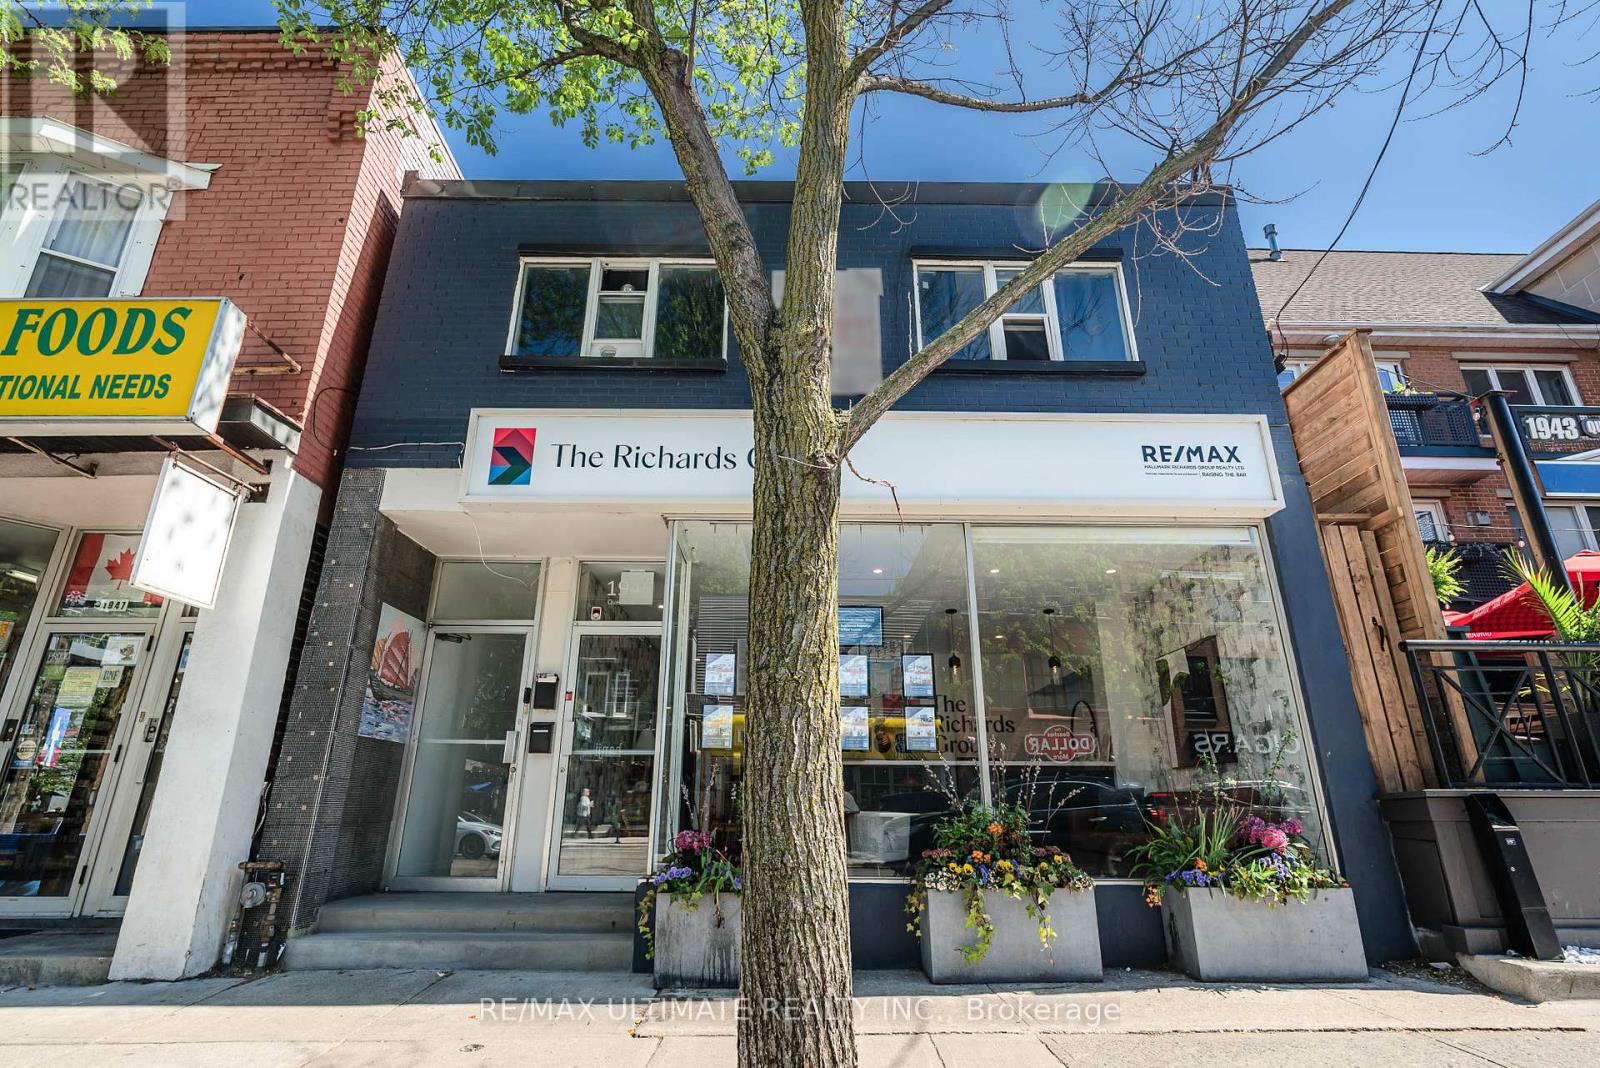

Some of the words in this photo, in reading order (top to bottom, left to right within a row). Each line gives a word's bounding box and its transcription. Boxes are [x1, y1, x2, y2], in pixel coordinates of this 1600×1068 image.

[0, 307, 192, 356] FOODS
[0, 374, 81, 400] TIONAL
[88, 374, 172, 400] NEEDS
[1526, 417, 1580, 440] 1943
[551, 443, 604, 468] The
[613, 444, 737, 470] Richards
[1141, 445, 1242, 463] RE/MAX
[935, 714, 1015, 733] Richrds
